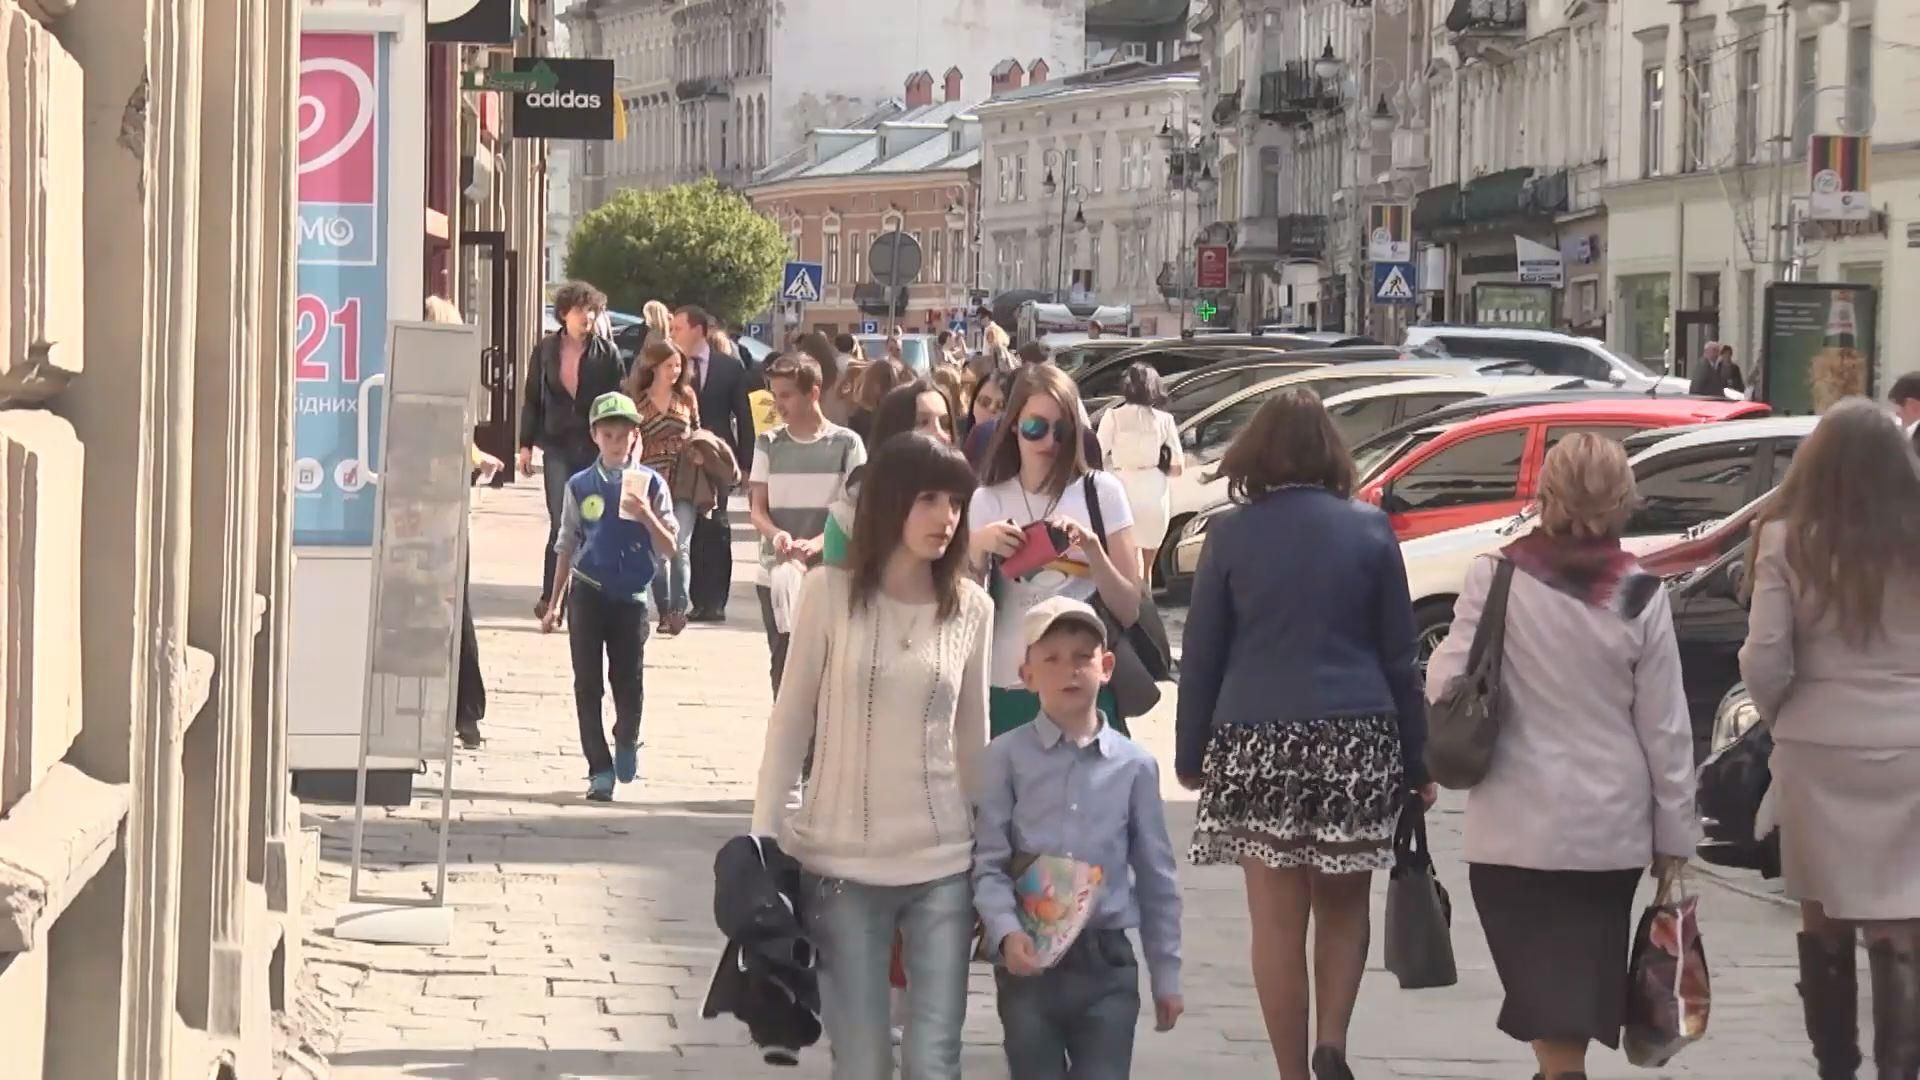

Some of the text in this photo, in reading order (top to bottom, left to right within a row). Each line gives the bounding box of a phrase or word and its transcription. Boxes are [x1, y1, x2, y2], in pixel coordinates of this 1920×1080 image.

[526, 89, 602, 109] adidas
[295, 293, 361, 383] 21
[294, 392, 358, 416] ідних
